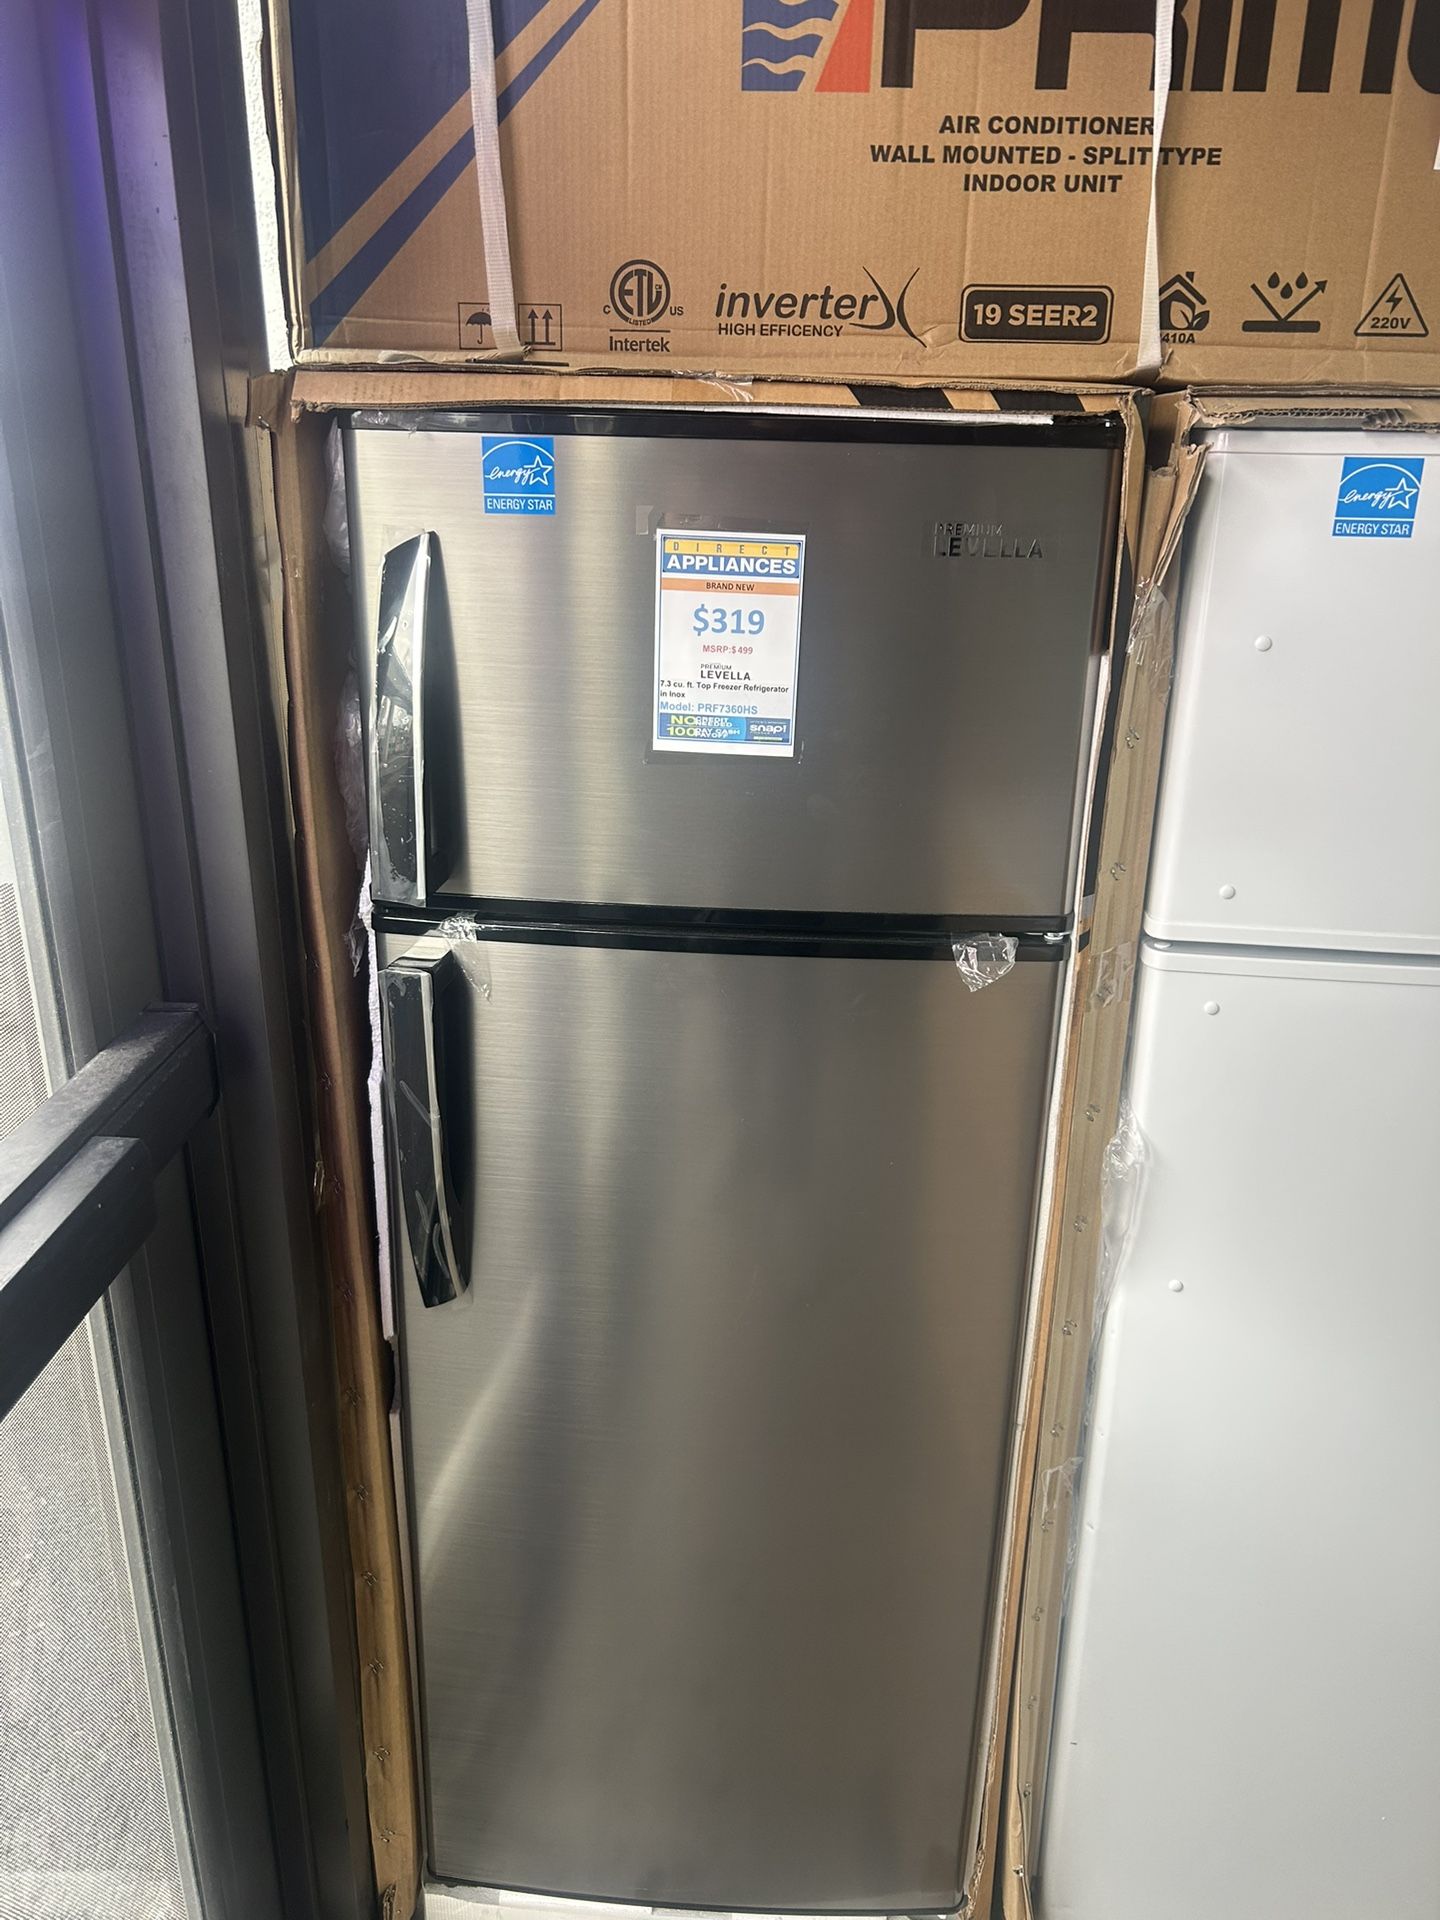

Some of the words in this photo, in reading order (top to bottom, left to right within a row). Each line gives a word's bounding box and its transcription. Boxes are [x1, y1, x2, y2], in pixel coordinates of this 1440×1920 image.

[938, 115, 981, 134] AIR
[988, 115, 1154, 135] CONDITIONER
[870, 144, 935, 164] WALL
[942, 145, 1062, 165] MOUNTED
[1083, 146, 1152, 166] SPLIT
[1159, 147, 1223, 166] TYPE
[963, 173, 1056, 193] INDOOR
[1064, 174, 1123, 193] UNIT
[669, 305, 684, 316] US
[974, 303, 1002, 326] 19
[1008, 303, 1099, 327] SEER2
[628, 317, 653, 327] LISTED
[1370, 316, 1412, 330] 220V
[718, 322, 756, 336] HIGH
[760, 323, 844, 337] EFFICENCY
[609, 335, 671, 353] Intertek
[486, 498, 526, 510] ENERGY
[527, 498, 553, 511] STAR
[1335, 522, 1380, 535] ENERGY
[1380, 523, 1410, 535] STAR
[673, 541, 791, 556] DIRECT
[667, 554, 796, 575] APPLIANCES
[706, 582, 734, 591] BRAND
[735, 583, 755, 592] NEW
[692, 603, 765, 637] $319
[700, 663, 732, 671] PREMIUM
[700, 670, 751, 681] LEVELLA
[660, 680, 672, 688] 7.3
[687, 681, 695, 689] ft.
[697, 681, 711, 691] Top
[713, 683, 742, 691] Freezer
[743, 684, 789, 694] Refrigerator
[669, 690, 686, 698] Inox
[660, 701, 695, 711] Model:
[697, 703, 758, 715] PRF7360HS
[670, 715, 697, 725] NO
[749, 724, 787, 734] snap!
